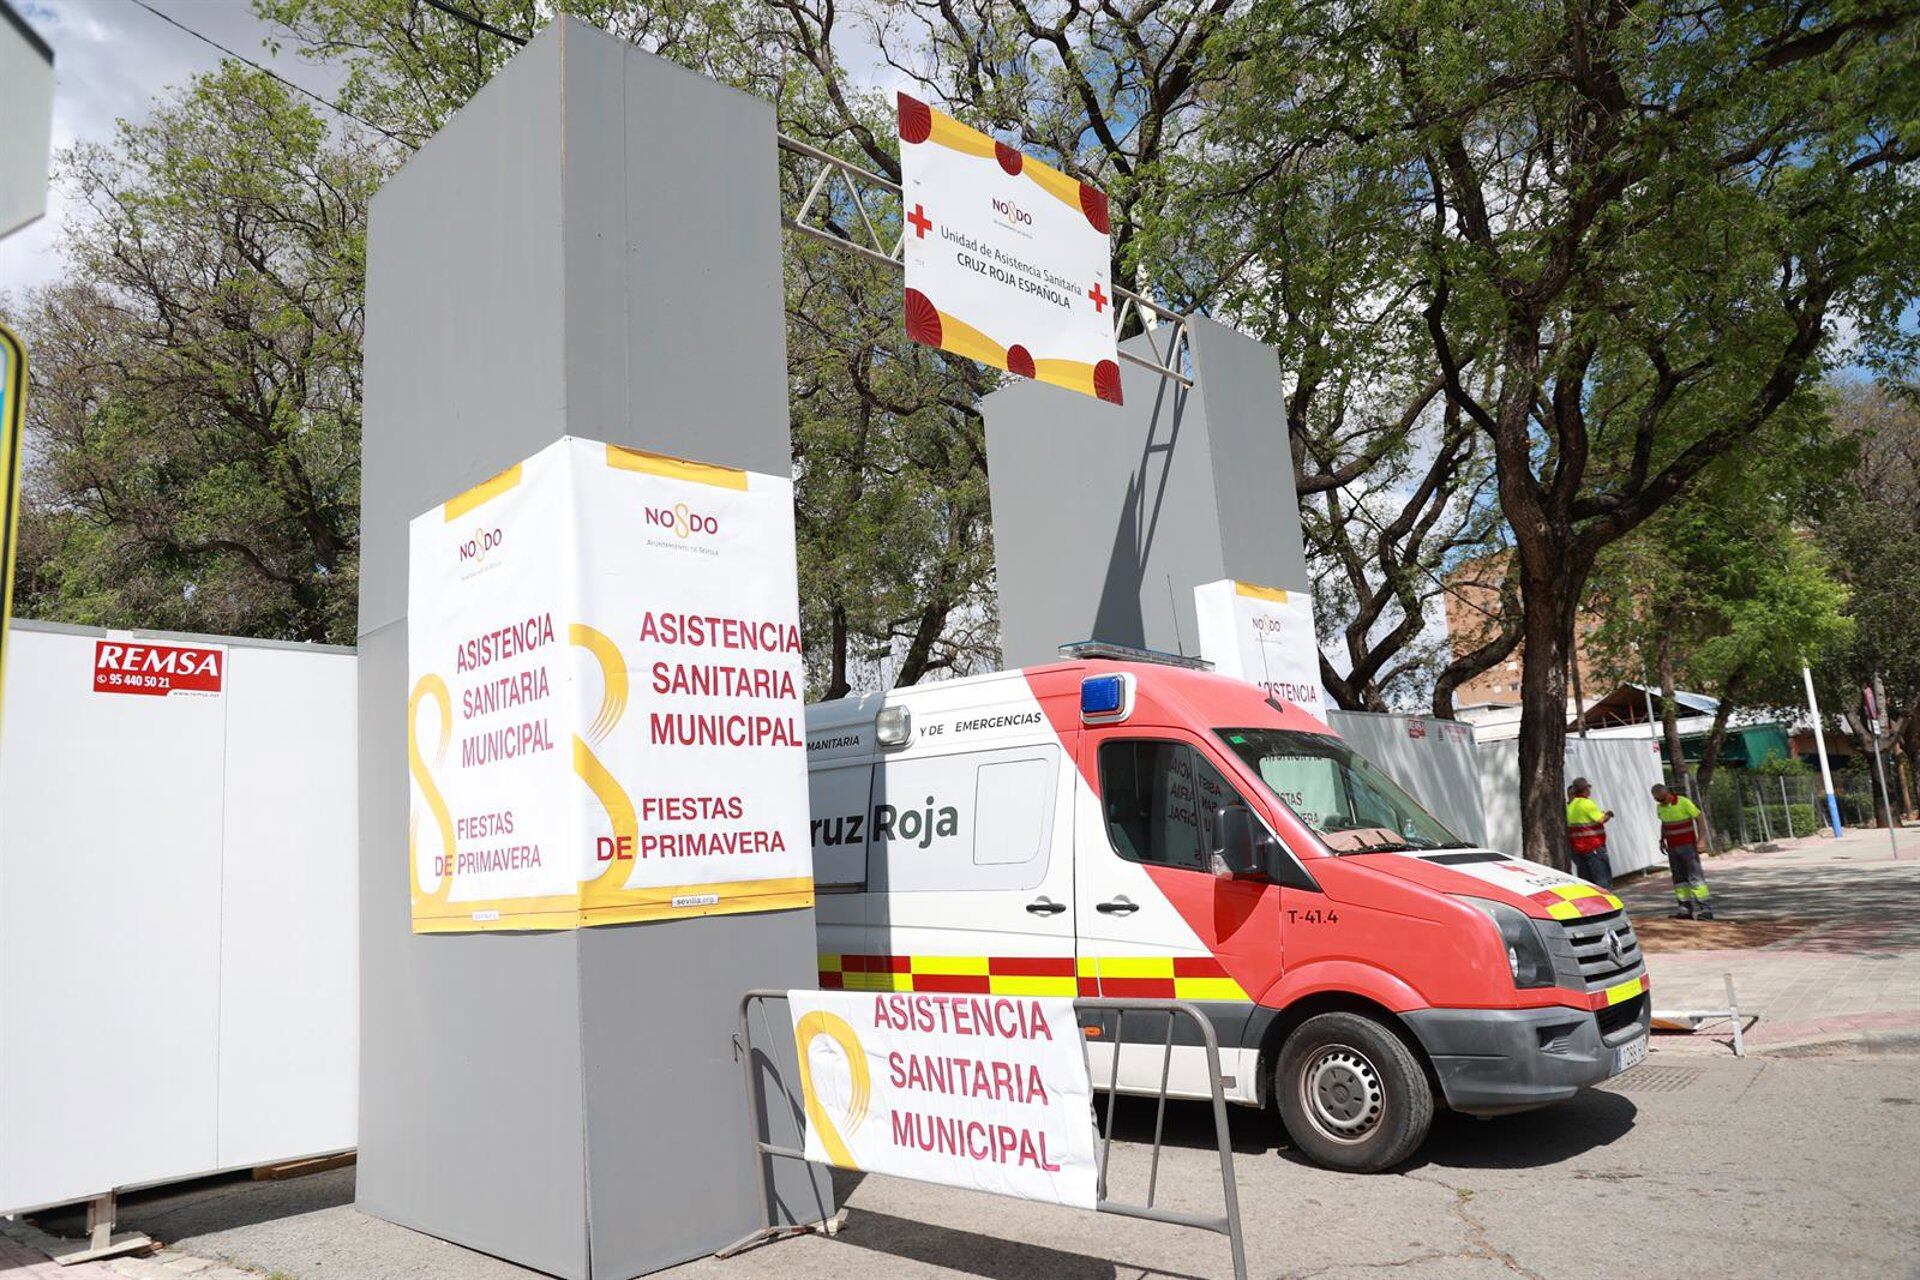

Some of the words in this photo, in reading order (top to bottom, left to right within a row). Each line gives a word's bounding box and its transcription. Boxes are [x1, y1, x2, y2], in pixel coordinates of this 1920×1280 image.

[941, 225, 977, 251] Unidad
[980, 243, 992, 258] de
[994, 249, 1041, 279] Asistencia
[1043, 270, 1082, 296] Sanitaria
[957, 252, 987, 275] CRUZ
[990, 265, 1016, 287] ROJA
[1018, 277, 1071, 309] ESPAÑOLA
[456, 612, 555, 674] ASISTENCIA
[640, 611, 801, 654] ASISTENCIA
[97, 645, 218, 676] REMSA
[109, 674, 122, 685] 95
[124, 675, 142, 687] 440
[144, 676, 156, 688] 50
[158, 677, 170, 688] 21
[652, 661, 797, 700] SANITARIA
[463, 673, 550, 720] SANITARIA
[461, 718, 554, 769] MUNICIPAL
[650, 713, 802, 747] MUNICIPAL
[806, 735, 860, 751] MANITARIA
[920, 726, 927, 737] Y
[929, 724, 944, 736] DE
[955, 712, 1042, 732] EMERGENCIAS
[457, 811, 514, 841] FIESTAS
[642, 796, 743, 821] FIESTAS
[810, 815, 864, 847] ruz
[873, 796, 958, 849] Roja
[434, 854, 453, 877] DE
[457, 844, 542, 875] PRIMAVERA
[597, 836, 633, 861] DE
[642, 830, 786, 859] PRIMAVERA
[1287, 909, 1339, 924] T-41.4
[874, 994, 1053, 1041] ASISTENCIA
[889, 1051, 1049, 1106] SANITARIA
[891, 1110, 1060, 1172] MUNICIPAL
